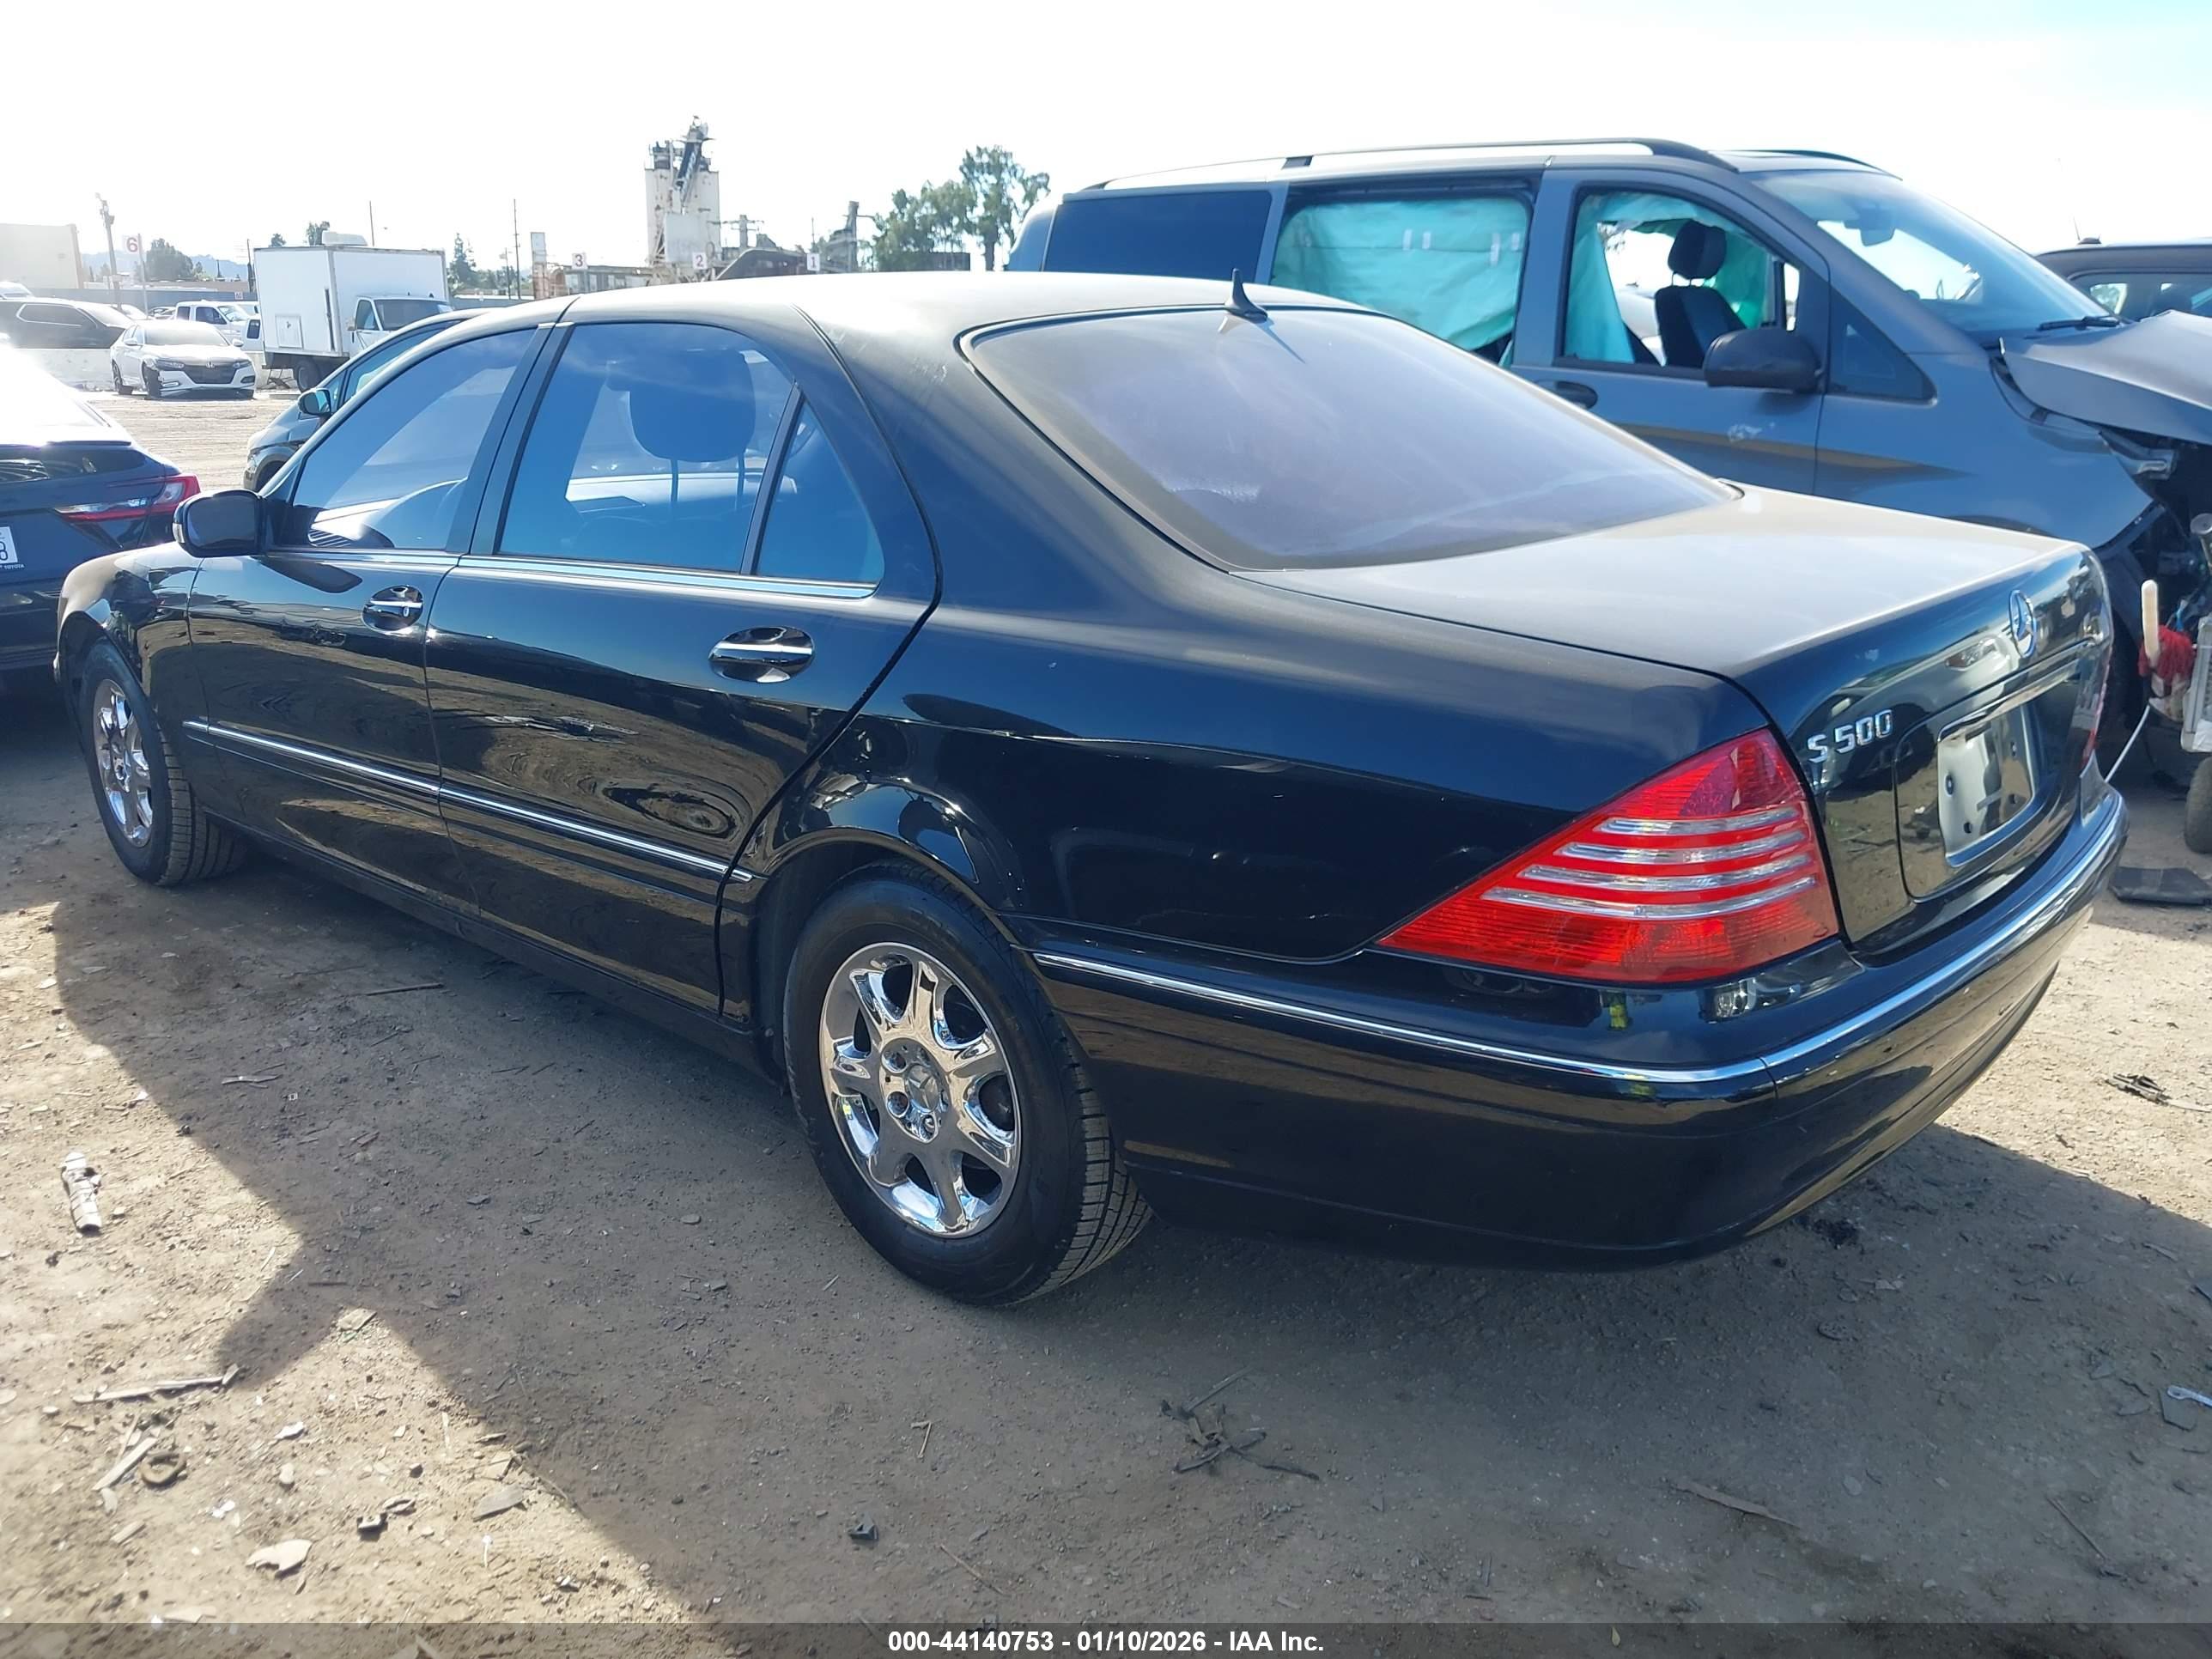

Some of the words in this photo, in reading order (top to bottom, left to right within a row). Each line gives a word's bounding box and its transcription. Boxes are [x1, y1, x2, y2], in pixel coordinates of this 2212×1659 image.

[126, 237, 138, 252] 6
[575, 253, 583, 267] 3
[696, 254, 703, 267] 2
[1808, 733, 1828, 763] S
[1834, 709, 1893, 754] 500
